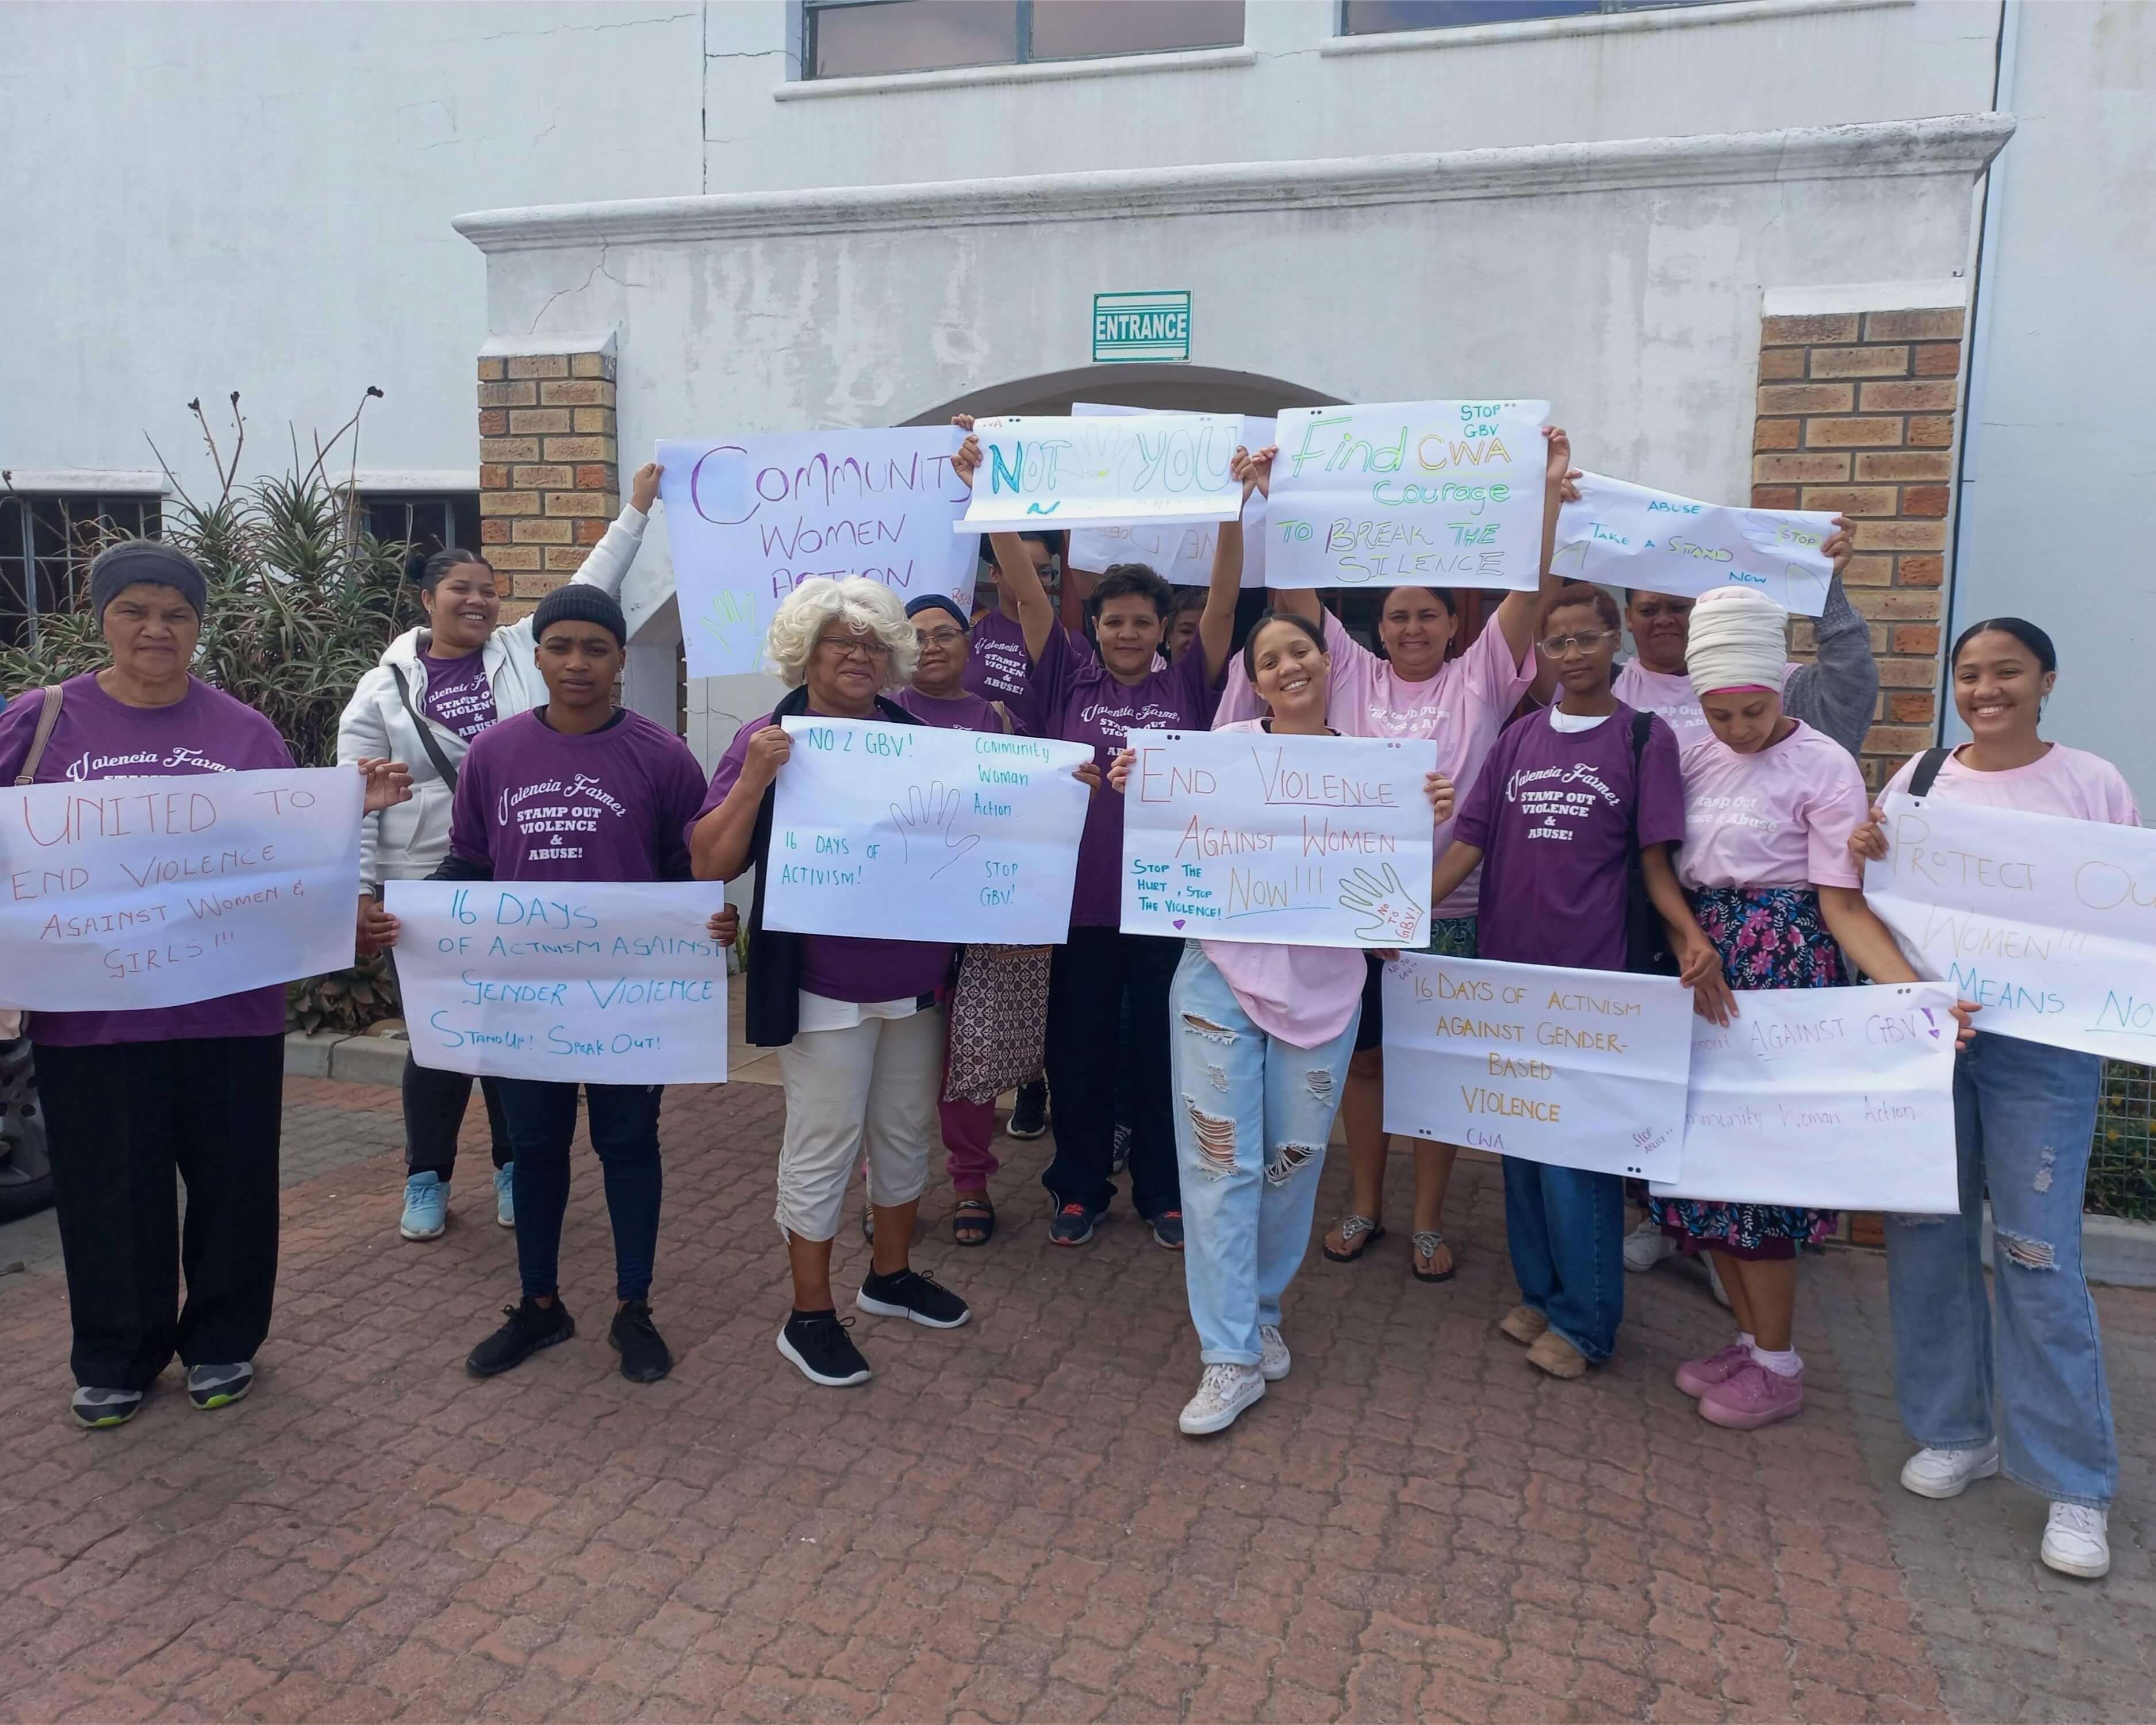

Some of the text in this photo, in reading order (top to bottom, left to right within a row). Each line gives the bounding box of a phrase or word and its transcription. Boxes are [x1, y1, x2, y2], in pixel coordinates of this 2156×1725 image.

[1096, 313, 1187, 340] ENTRANCE
[1461, 405, 1501, 421] STOP
[1463, 424, 1499, 438] GBV
[1292, 416, 1511, 477] Find CWA
[988, 426, 1238, 494] NOT YOU
[1373, 480, 1510, 516] Courage
[1647, 501, 1701, 514] ABUSE
[760, 513, 906, 559] WOMEN
[1275, 518, 1501, 554] TO BREAK THE
[1590, 522, 1629, 545] TAKE
[1644, 539, 1656, 548] A
[1782, 529, 1816, 545] STOP
[1336, 551, 1505, 582] SILENCE
[975, 637, 1019, 654] Valencia
[984, 653, 1021, 668] STAMP
[985, 660, 1026, 678] VIOLEN
[984, 677, 1024, 695] ABUSE!
[1003, 674, 1012, 682] &
[436, 696, 478, 711] STAMP
[1081, 703, 1134, 722] Valencia
[474, 713, 484, 722] &
[809, 727, 834, 752] NO
[866, 732, 914, 758] GBV!
[975, 737, 1050, 764] Community
[66, 751, 159, 782] Valencia
[977, 764, 1029, 787] Woman
[1141, 746, 1395, 805] END VIOLENCE
[1506, 763, 1620, 806] Valencia Farmer
[498, 773, 627, 826] Valencia Farmer
[1521, 791, 1596, 805] STAMP OUT
[1522, 803, 1589, 817] VIOLENCE
[24, 788, 315, 847] UNITED TO
[517, 807, 602, 822] STAMP OUT
[1544, 816, 1556, 826] &
[520, 820, 597, 835] VIOLENCE
[550, 834, 562, 845] &
[1175, 814, 1395, 861] AGAINST WOMEN
[1528, 828, 1573, 840] ABUSE!
[528, 848, 583, 861] ABUSE!
[785, 831, 881, 861] 16 DAYS OF
[1894, 814, 2036, 892] PROTECT
[11, 845, 276, 901] END VIOLENCE
[781, 864, 862, 886] ACTIVISM!
[985, 861, 1019, 879] STOP
[1130, 859, 1202, 877] STOP THE
[979, 884, 1015, 907] GBV!
[1138, 879, 1167, 891] HURT
[1187, 885, 1213, 898] STOP
[40, 905, 167, 941] AGAINST
[186, 885, 278, 920] WOMEN
[451, 888, 599, 929] 16 DAYS
[1138, 896, 1221, 920] THE VIOLENCE!
[1377, 903, 1389, 915] NO
[1388, 911, 1399, 923] TO
[1395, 907, 1419, 938] GBV!
[439, 936, 719, 957] OF ACTIVISM AGAINST
[461, 969, 567, 1006] GENDER
[1415, 972, 1641, 1018] 16 DAYS OF ACTIVISM
[1948, 961, 2154, 1028] MEANS NO
[548, 1025, 605, 1055] SPEAK
[611, 1034, 661, 1053] OUT!
[1436, 1016, 1629, 1054] AGAINST GENDER-
[1750, 1018, 1845, 1052] AGAINST
[1489, 1052, 1553, 1081] BASED
[1461, 1085, 1561, 1123] VIOLENCE
[1864, 1095, 1916, 1124] Action
[1467, 1127, 1505, 1151] CWA
